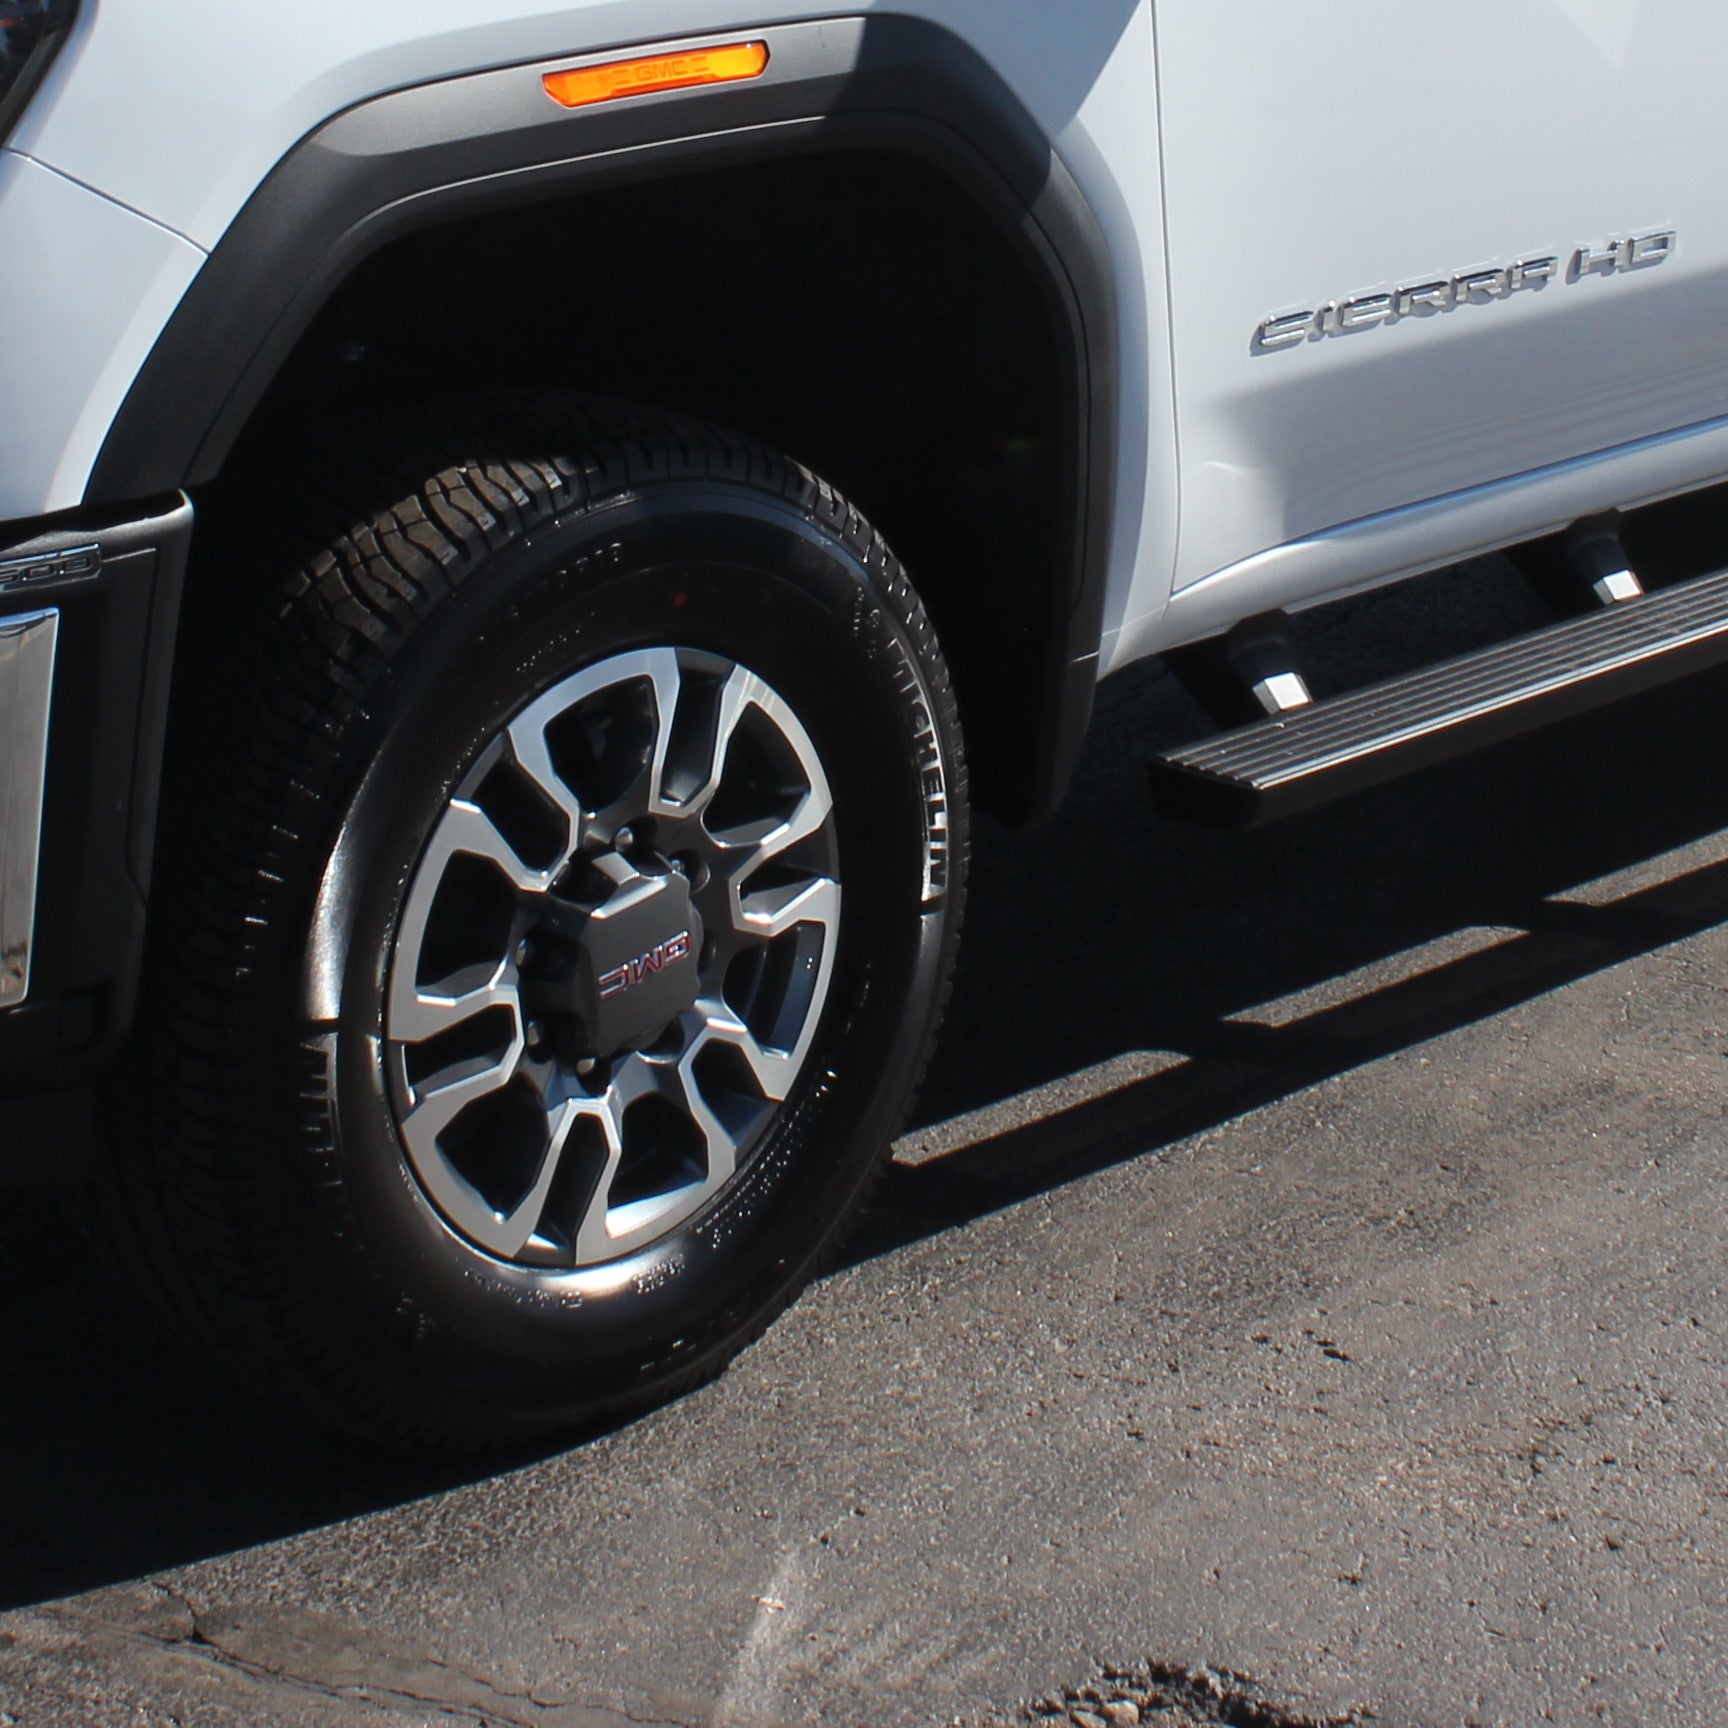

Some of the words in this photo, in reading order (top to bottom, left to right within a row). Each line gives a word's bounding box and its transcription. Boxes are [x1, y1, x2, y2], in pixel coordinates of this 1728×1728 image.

[1257, 256, 1559, 347] SIERRA
[1574, 229, 1678, 276] HD
[597, 930, 692, 1001] GMC
